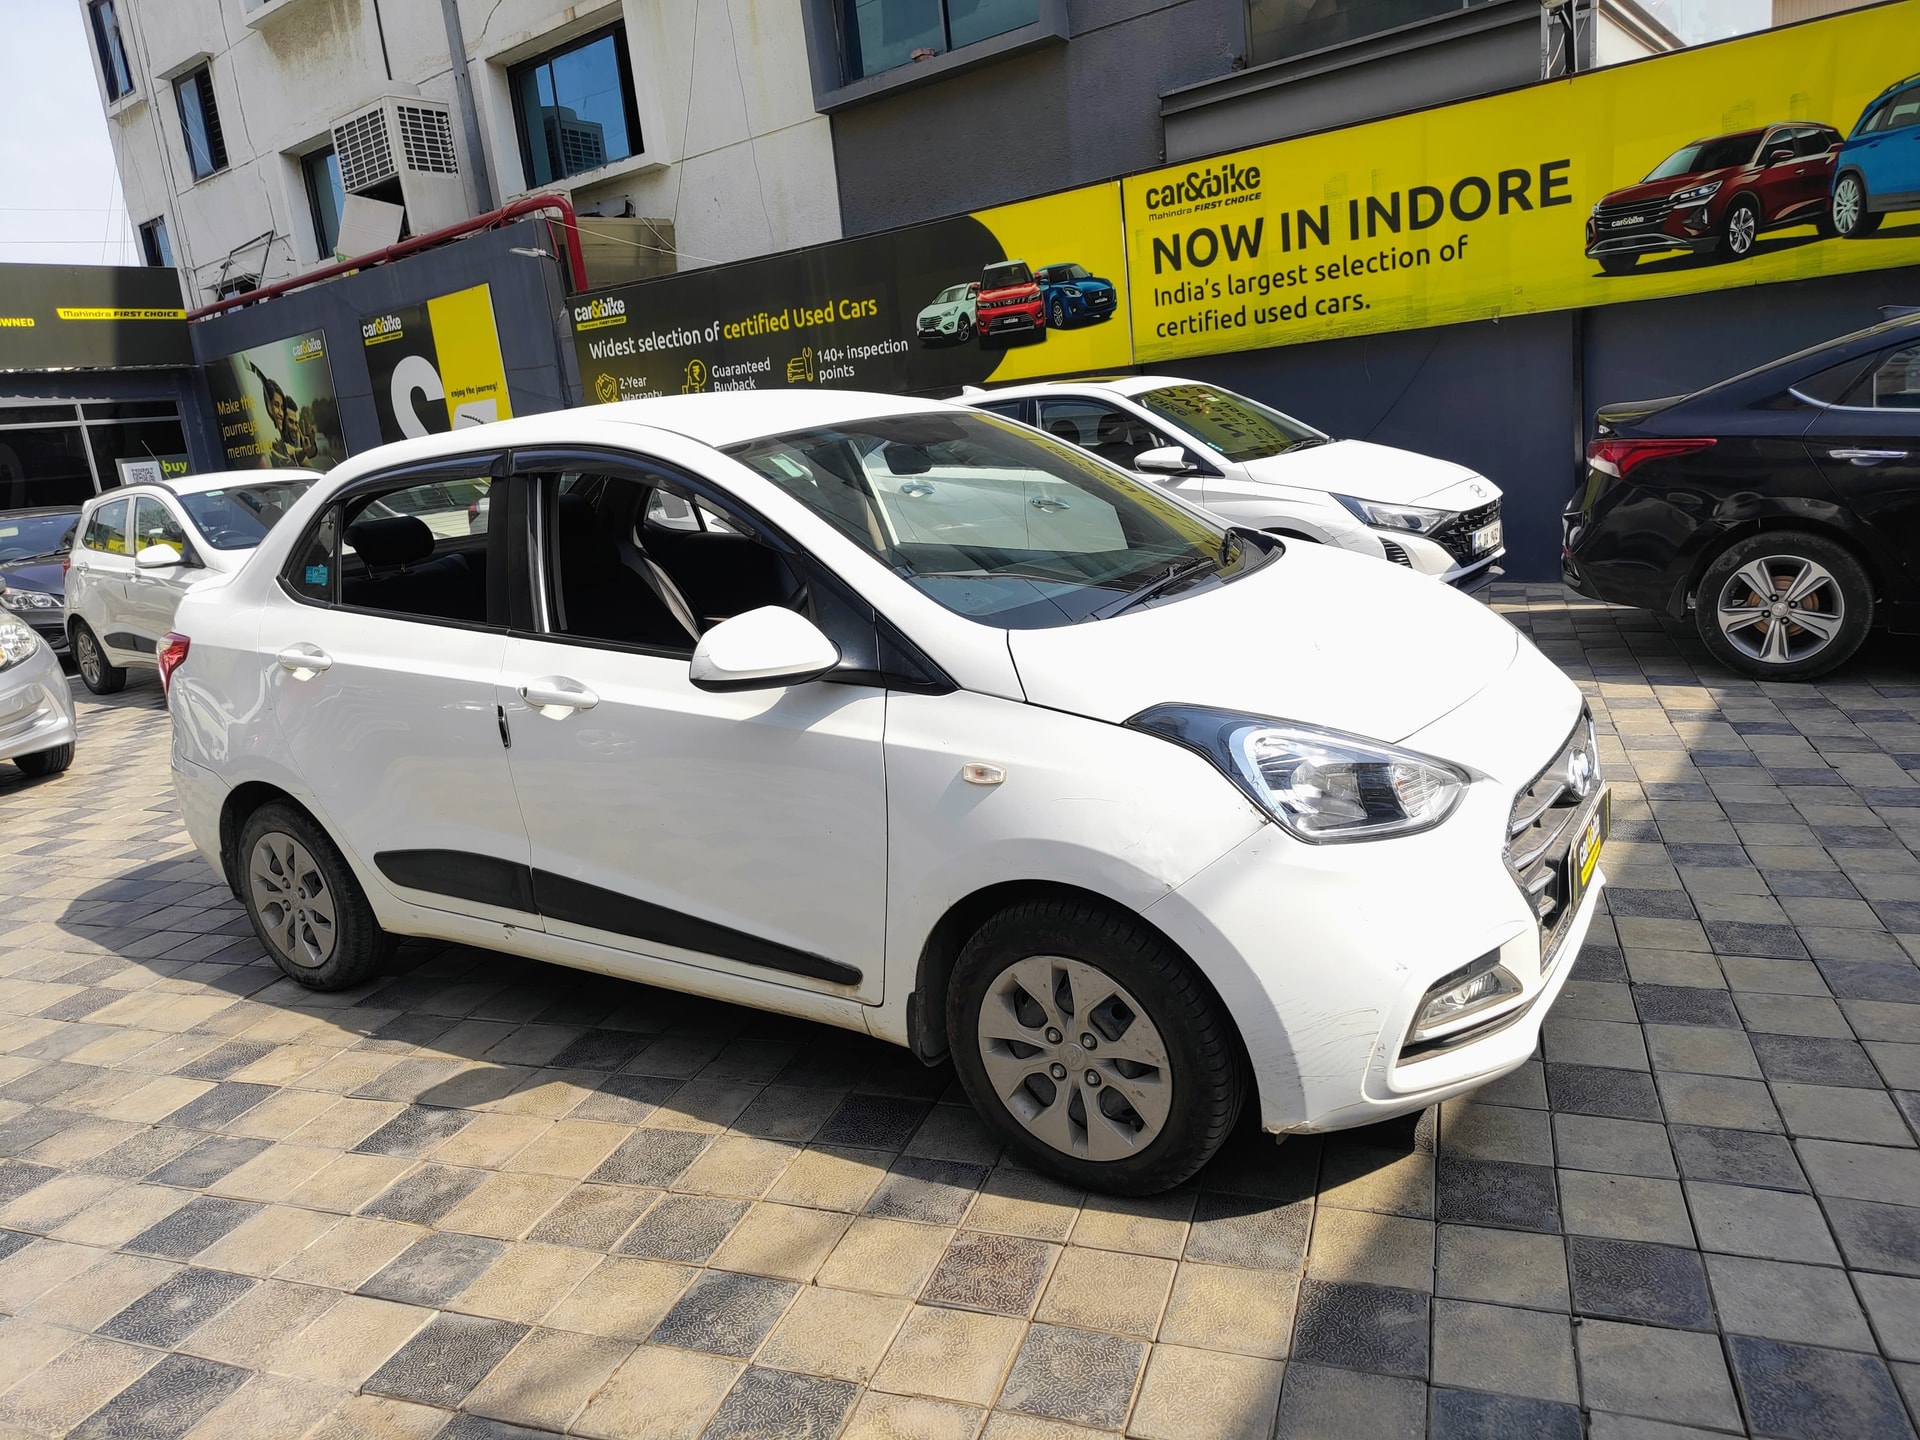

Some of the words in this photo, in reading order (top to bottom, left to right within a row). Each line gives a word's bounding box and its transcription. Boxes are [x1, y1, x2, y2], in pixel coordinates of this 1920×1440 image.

[1146, 163, 1261, 210] car&bike
[1149, 208, 1192, 221] Mahindra
[1194, 200, 1223, 212] FIRST
[1225, 192, 1261, 206] CHOICE
[1152, 217, 1264, 275] NOW
[1281, 205, 1330, 253] IN
[1349, 158, 1572, 241] INDORE
[1155, 278, 1221, 307] India's
[1228, 264, 1308, 296] largest
[1315, 247, 1430, 282] selection
[1440, 234, 1468, 262] of
[63, 310, 111, 318] Mahindra
[113, 310, 142, 318] FIRST
[143, 310, 179, 318] CHOICE
[574, 297, 625, 321] car&bike
[1156, 305, 1247, 338] certified
[1254, 296, 1307, 324] used
[1315, 293, 1370, 316] cars.
[362, 315, 402, 338] car&bike
[589, 337, 636, 360] Widest
[638, 327, 701, 353] selection
[705, 320, 721, 342] of
[723, 308, 790, 340] certified
[793, 300, 835, 328] Used
[838, 298, 878, 320] Cars
[292, 338, 322, 356] car&bike
[817, 349, 844, 363] 140+
[846, 339, 909, 359] inspection
[711, 356, 771, 378] Guaranteed
[819, 364, 855, 383] points
[451, 388, 466, 398] enjoy
[466, 386, 475, 395] the
[475, 381, 498, 395] journey!
[619, 376, 647, 390] 2-Year
[714, 376, 757, 392] Buyback
[216, 398, 240, 416] Make
[221, 420, 258, 442] journeys
[161, 460, 187, 474] buy
